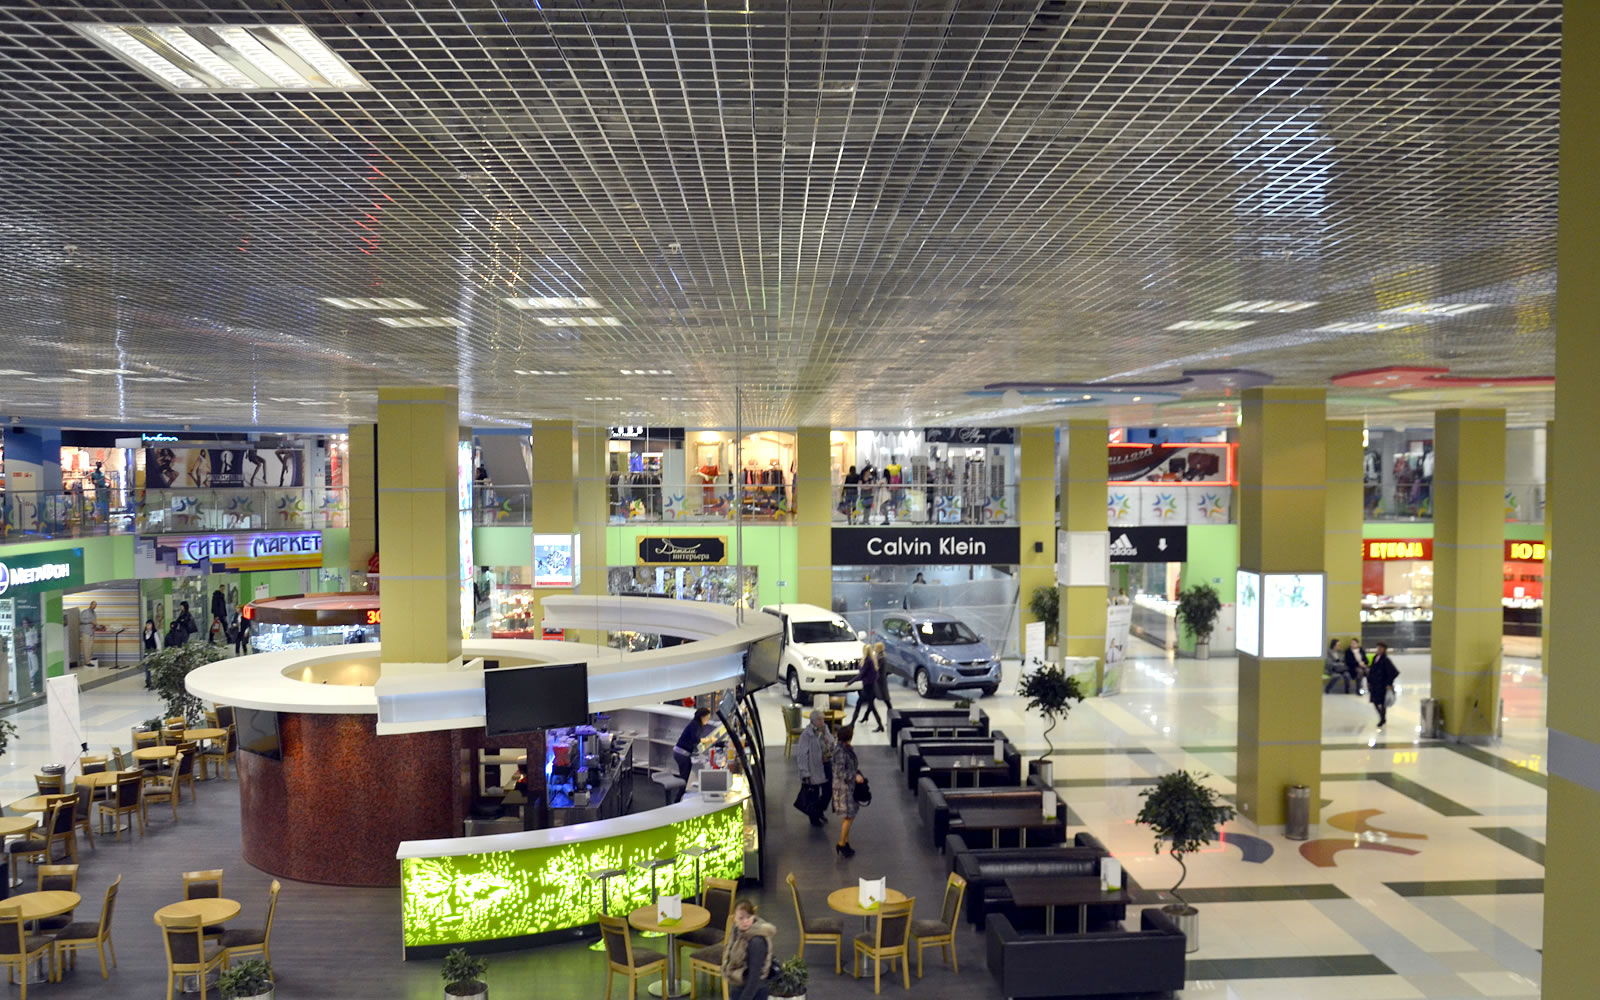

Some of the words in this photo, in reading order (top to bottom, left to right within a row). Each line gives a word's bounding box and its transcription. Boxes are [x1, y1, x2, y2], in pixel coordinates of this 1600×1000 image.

[186, 538, 233, 561] СИТИ
[252, 535, 321, 557] МАРКЕТ
[867, 537, 931, 556] Calvin
[939, 536, 986, 555] Klein
